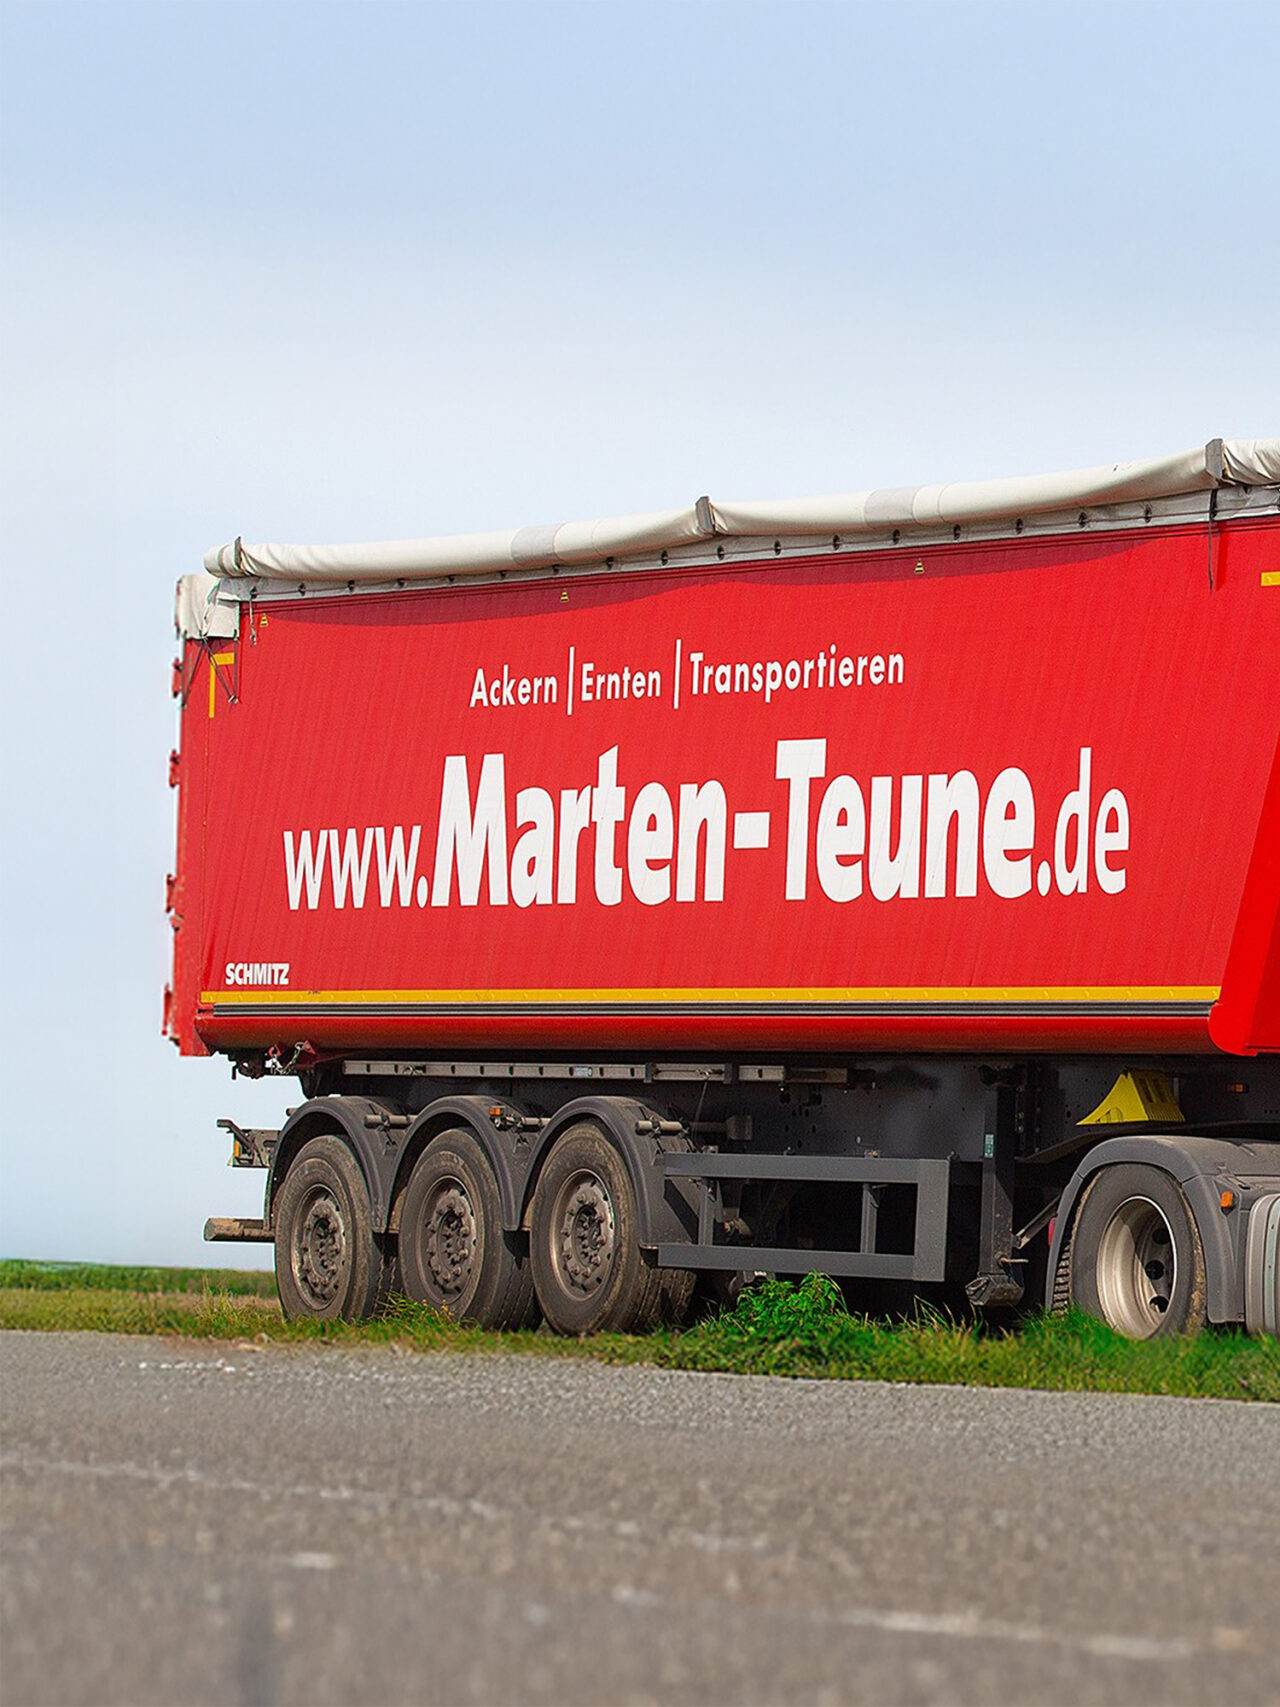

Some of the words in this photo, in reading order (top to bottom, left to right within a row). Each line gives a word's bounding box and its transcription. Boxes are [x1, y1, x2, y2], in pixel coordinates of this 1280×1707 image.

[469, 664, 558, 708] Ackern
[581, 662, 661, 702] Ernten
[690, 644, 904, 703] Transportieren
[283, 738, 1130, 910] www.Marten-Teune.de
[225, 962, 290, 985] SCHMITZ
